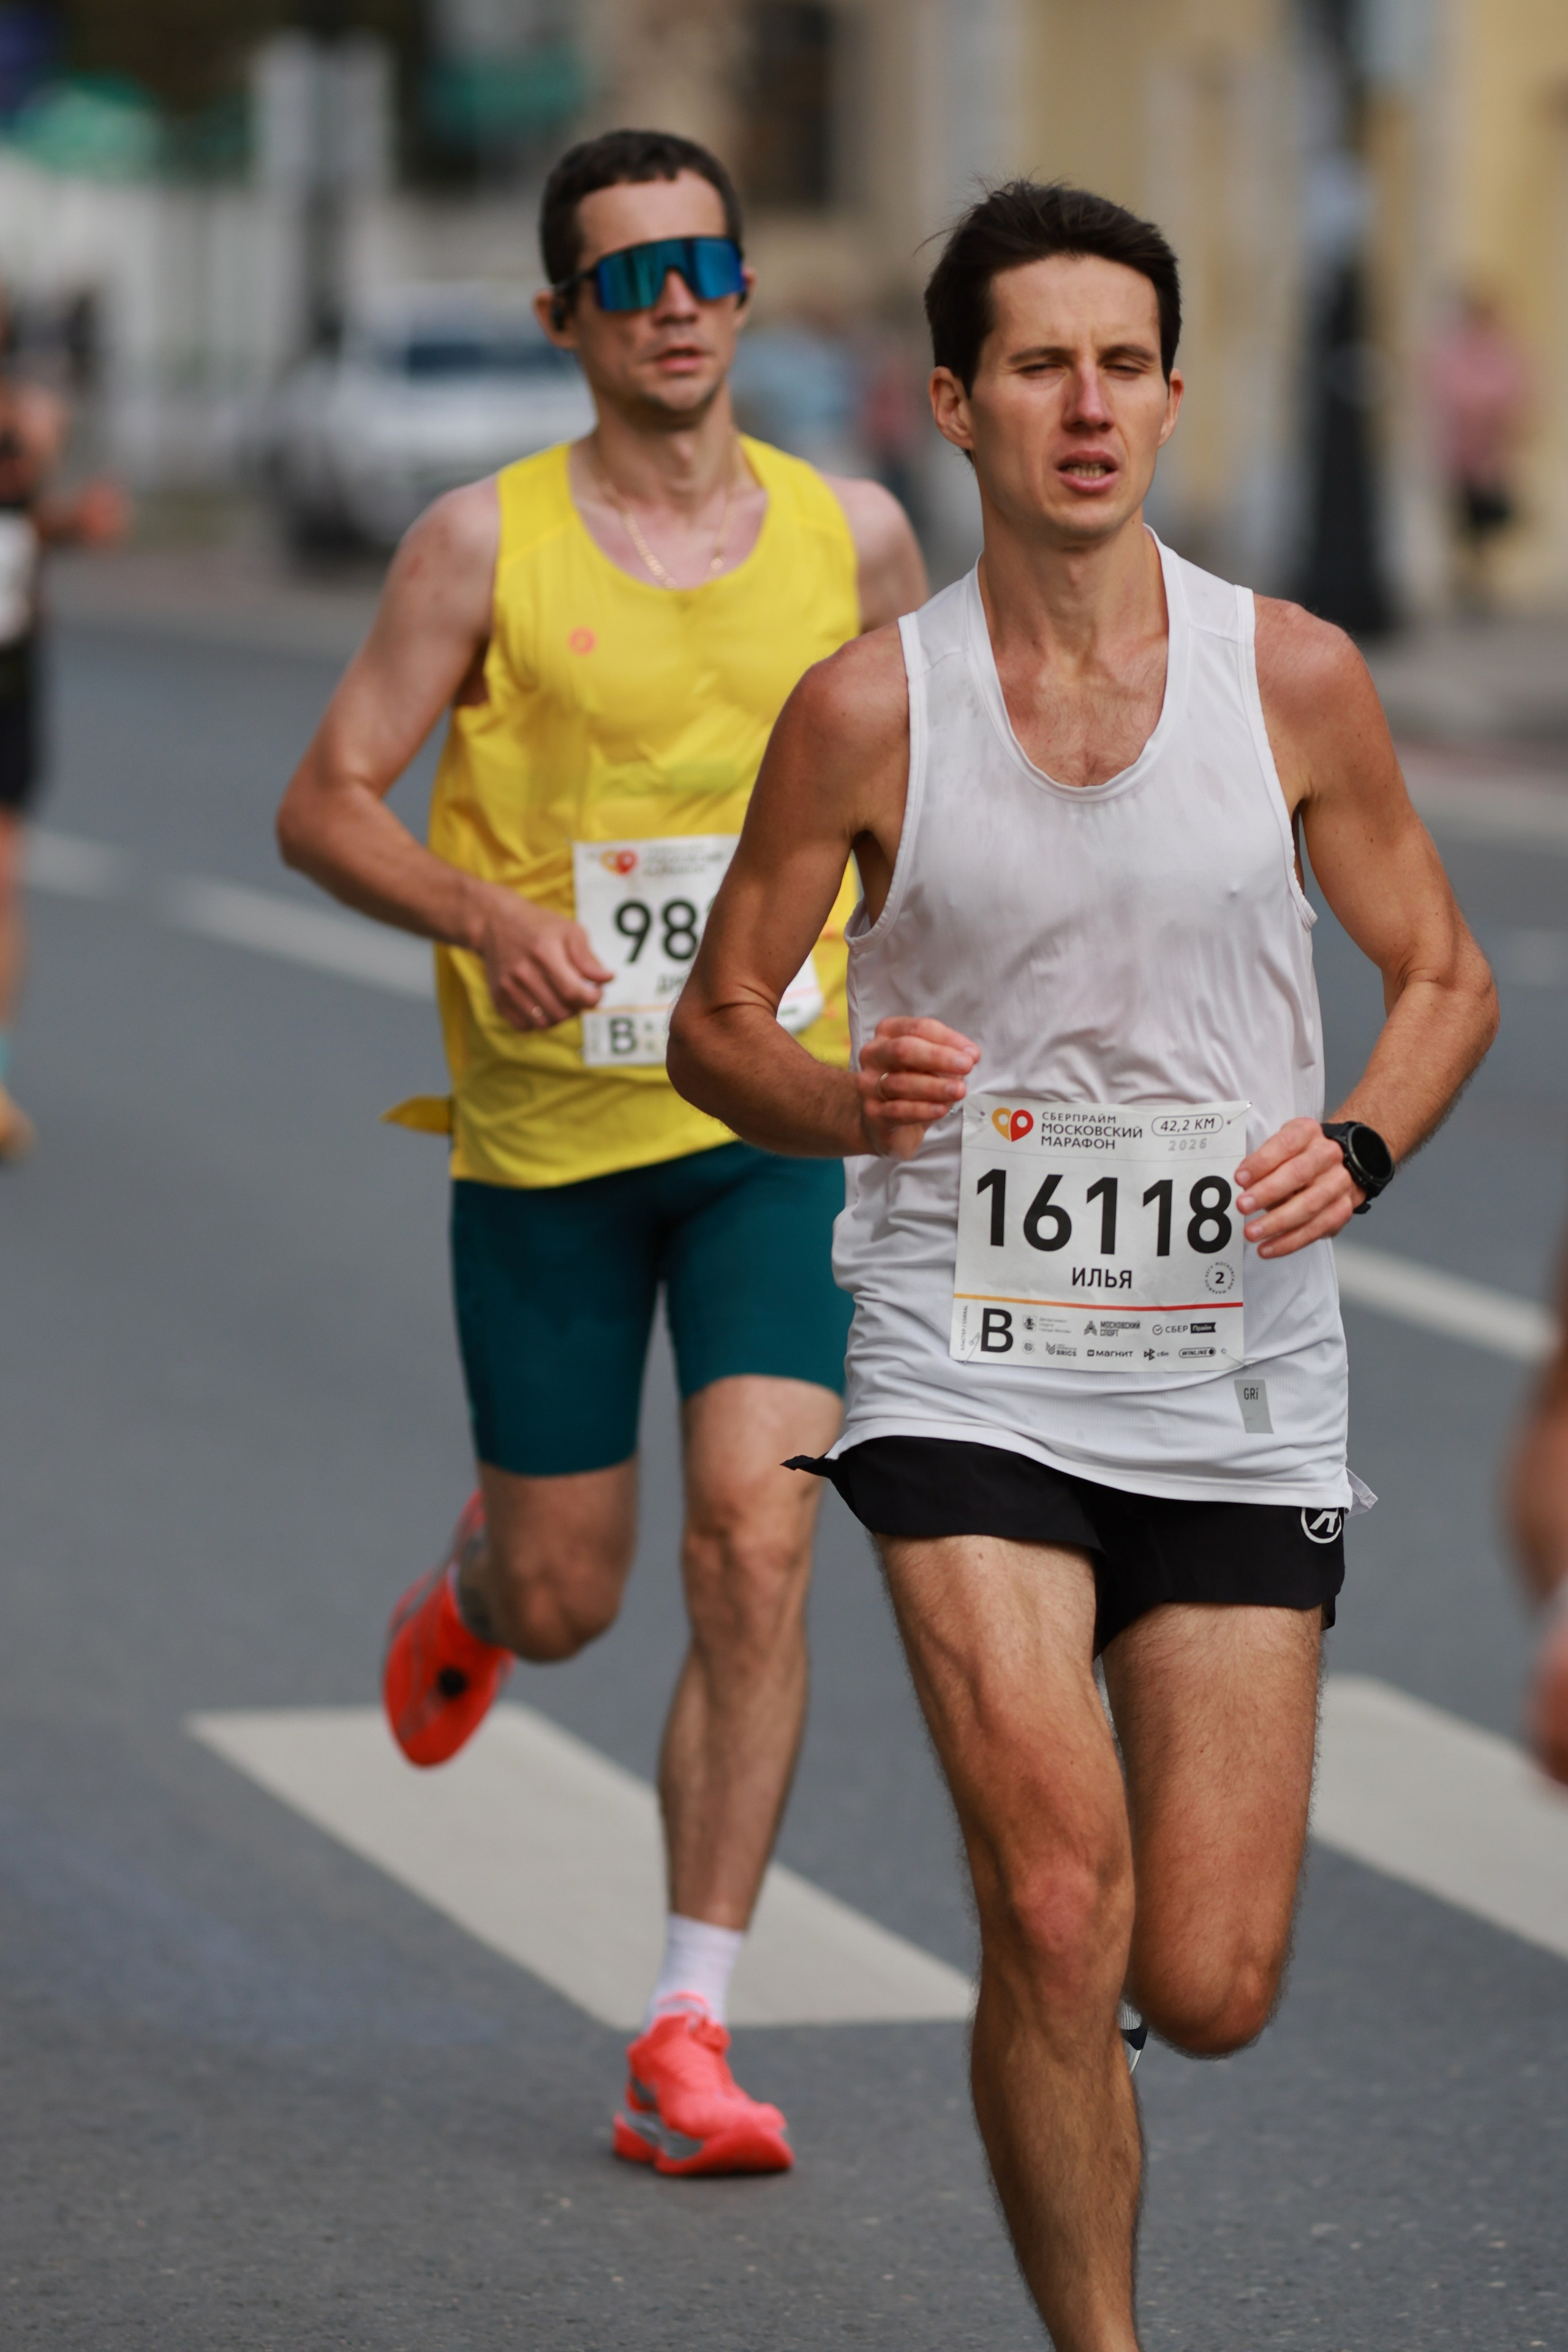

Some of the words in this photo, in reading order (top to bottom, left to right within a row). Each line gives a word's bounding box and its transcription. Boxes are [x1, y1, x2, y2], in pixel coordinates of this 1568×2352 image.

[614, 897, 715, 963] 98
[1042, 1112, 1116, 1123] СБЕРПРАЙМ
[1041, 1123, 1142, 1138] МОСКОВСКИЙ
[1160, 1120, 1189, 1133] 42,2
[1041, 1136, 1115, 1150] МАРАФОН
[976, 1169, 1232, 1256] 16118
[1071, 1267, 1133, 1289] ИЛЬЯ
[1215, 1272, 1224, 1284] 2
[981, 1308, 1014, 1353] B
[1165, 1325, 1188, 1333] СБЕР
[1243, 1387, 1259, 1400] GRi
